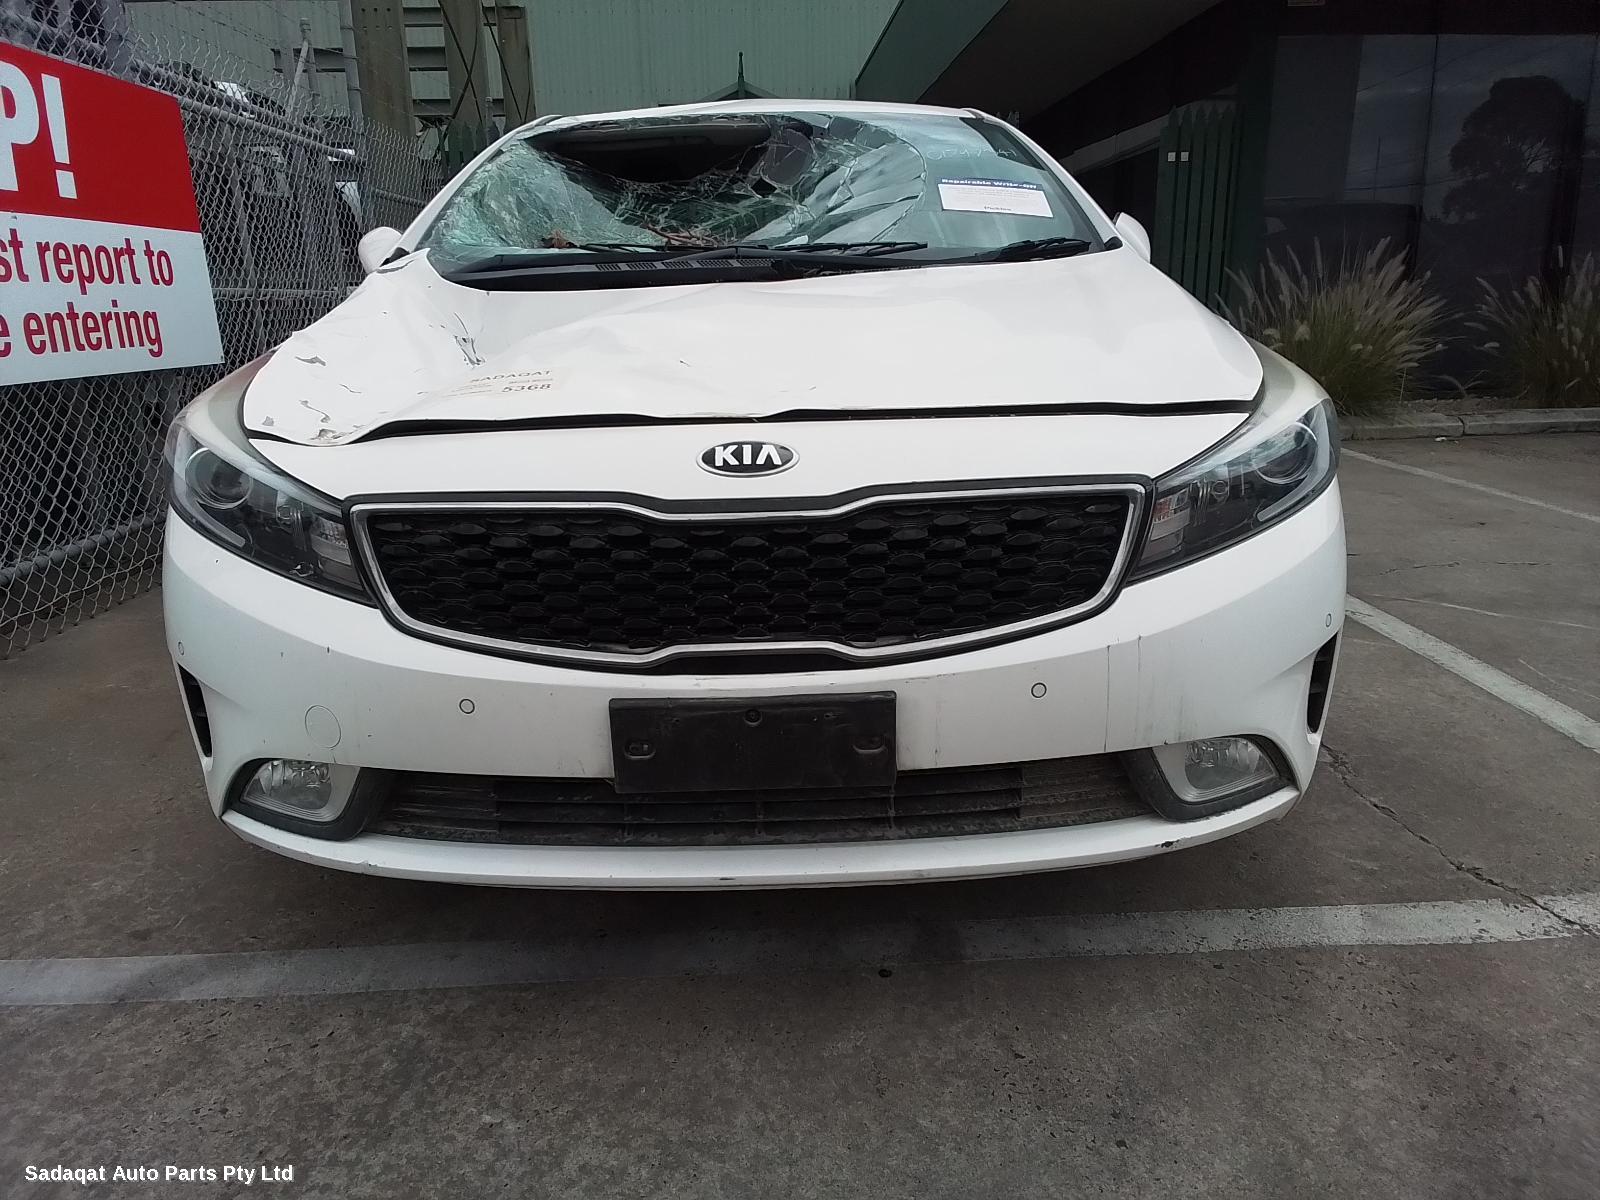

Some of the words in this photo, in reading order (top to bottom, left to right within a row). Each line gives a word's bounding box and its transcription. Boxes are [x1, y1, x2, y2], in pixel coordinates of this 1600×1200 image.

[36, 238, 141, 295] report
[144, 240, 174, 286] to
[23, 300, 163, 358] entering
[502, 383, 552, 393] 5368
[714, 444, 783, 467] KIA
